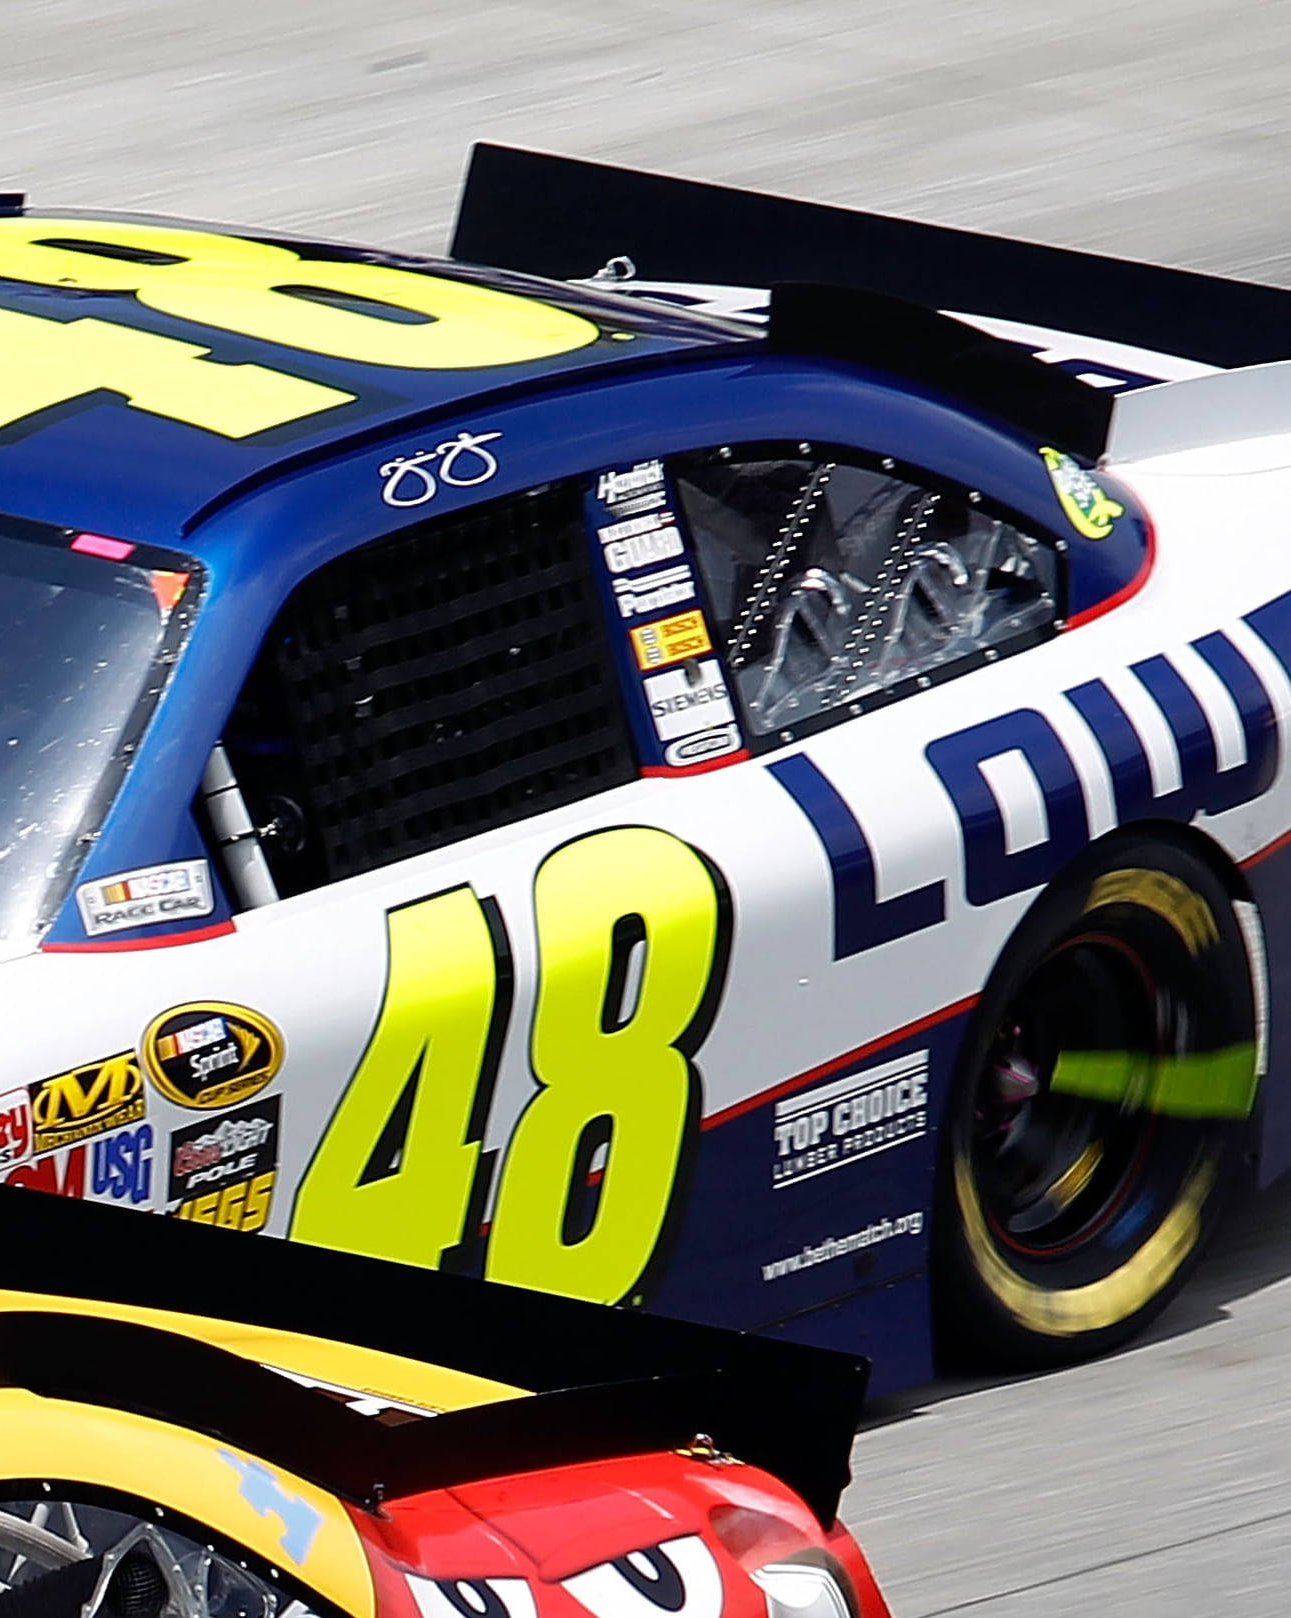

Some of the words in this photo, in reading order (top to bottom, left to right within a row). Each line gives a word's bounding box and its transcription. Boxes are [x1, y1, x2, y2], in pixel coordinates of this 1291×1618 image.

[190, 1042, 240, 1082] Sprint
[287, 824, 732, 1308] 48
[774, 1111, 829, 1156] TOP
[833, 1072, 929, 1136] CHOICE
[92, 1123, 155, 1204] USG
[186, 1152, 259, 1189] POLE
